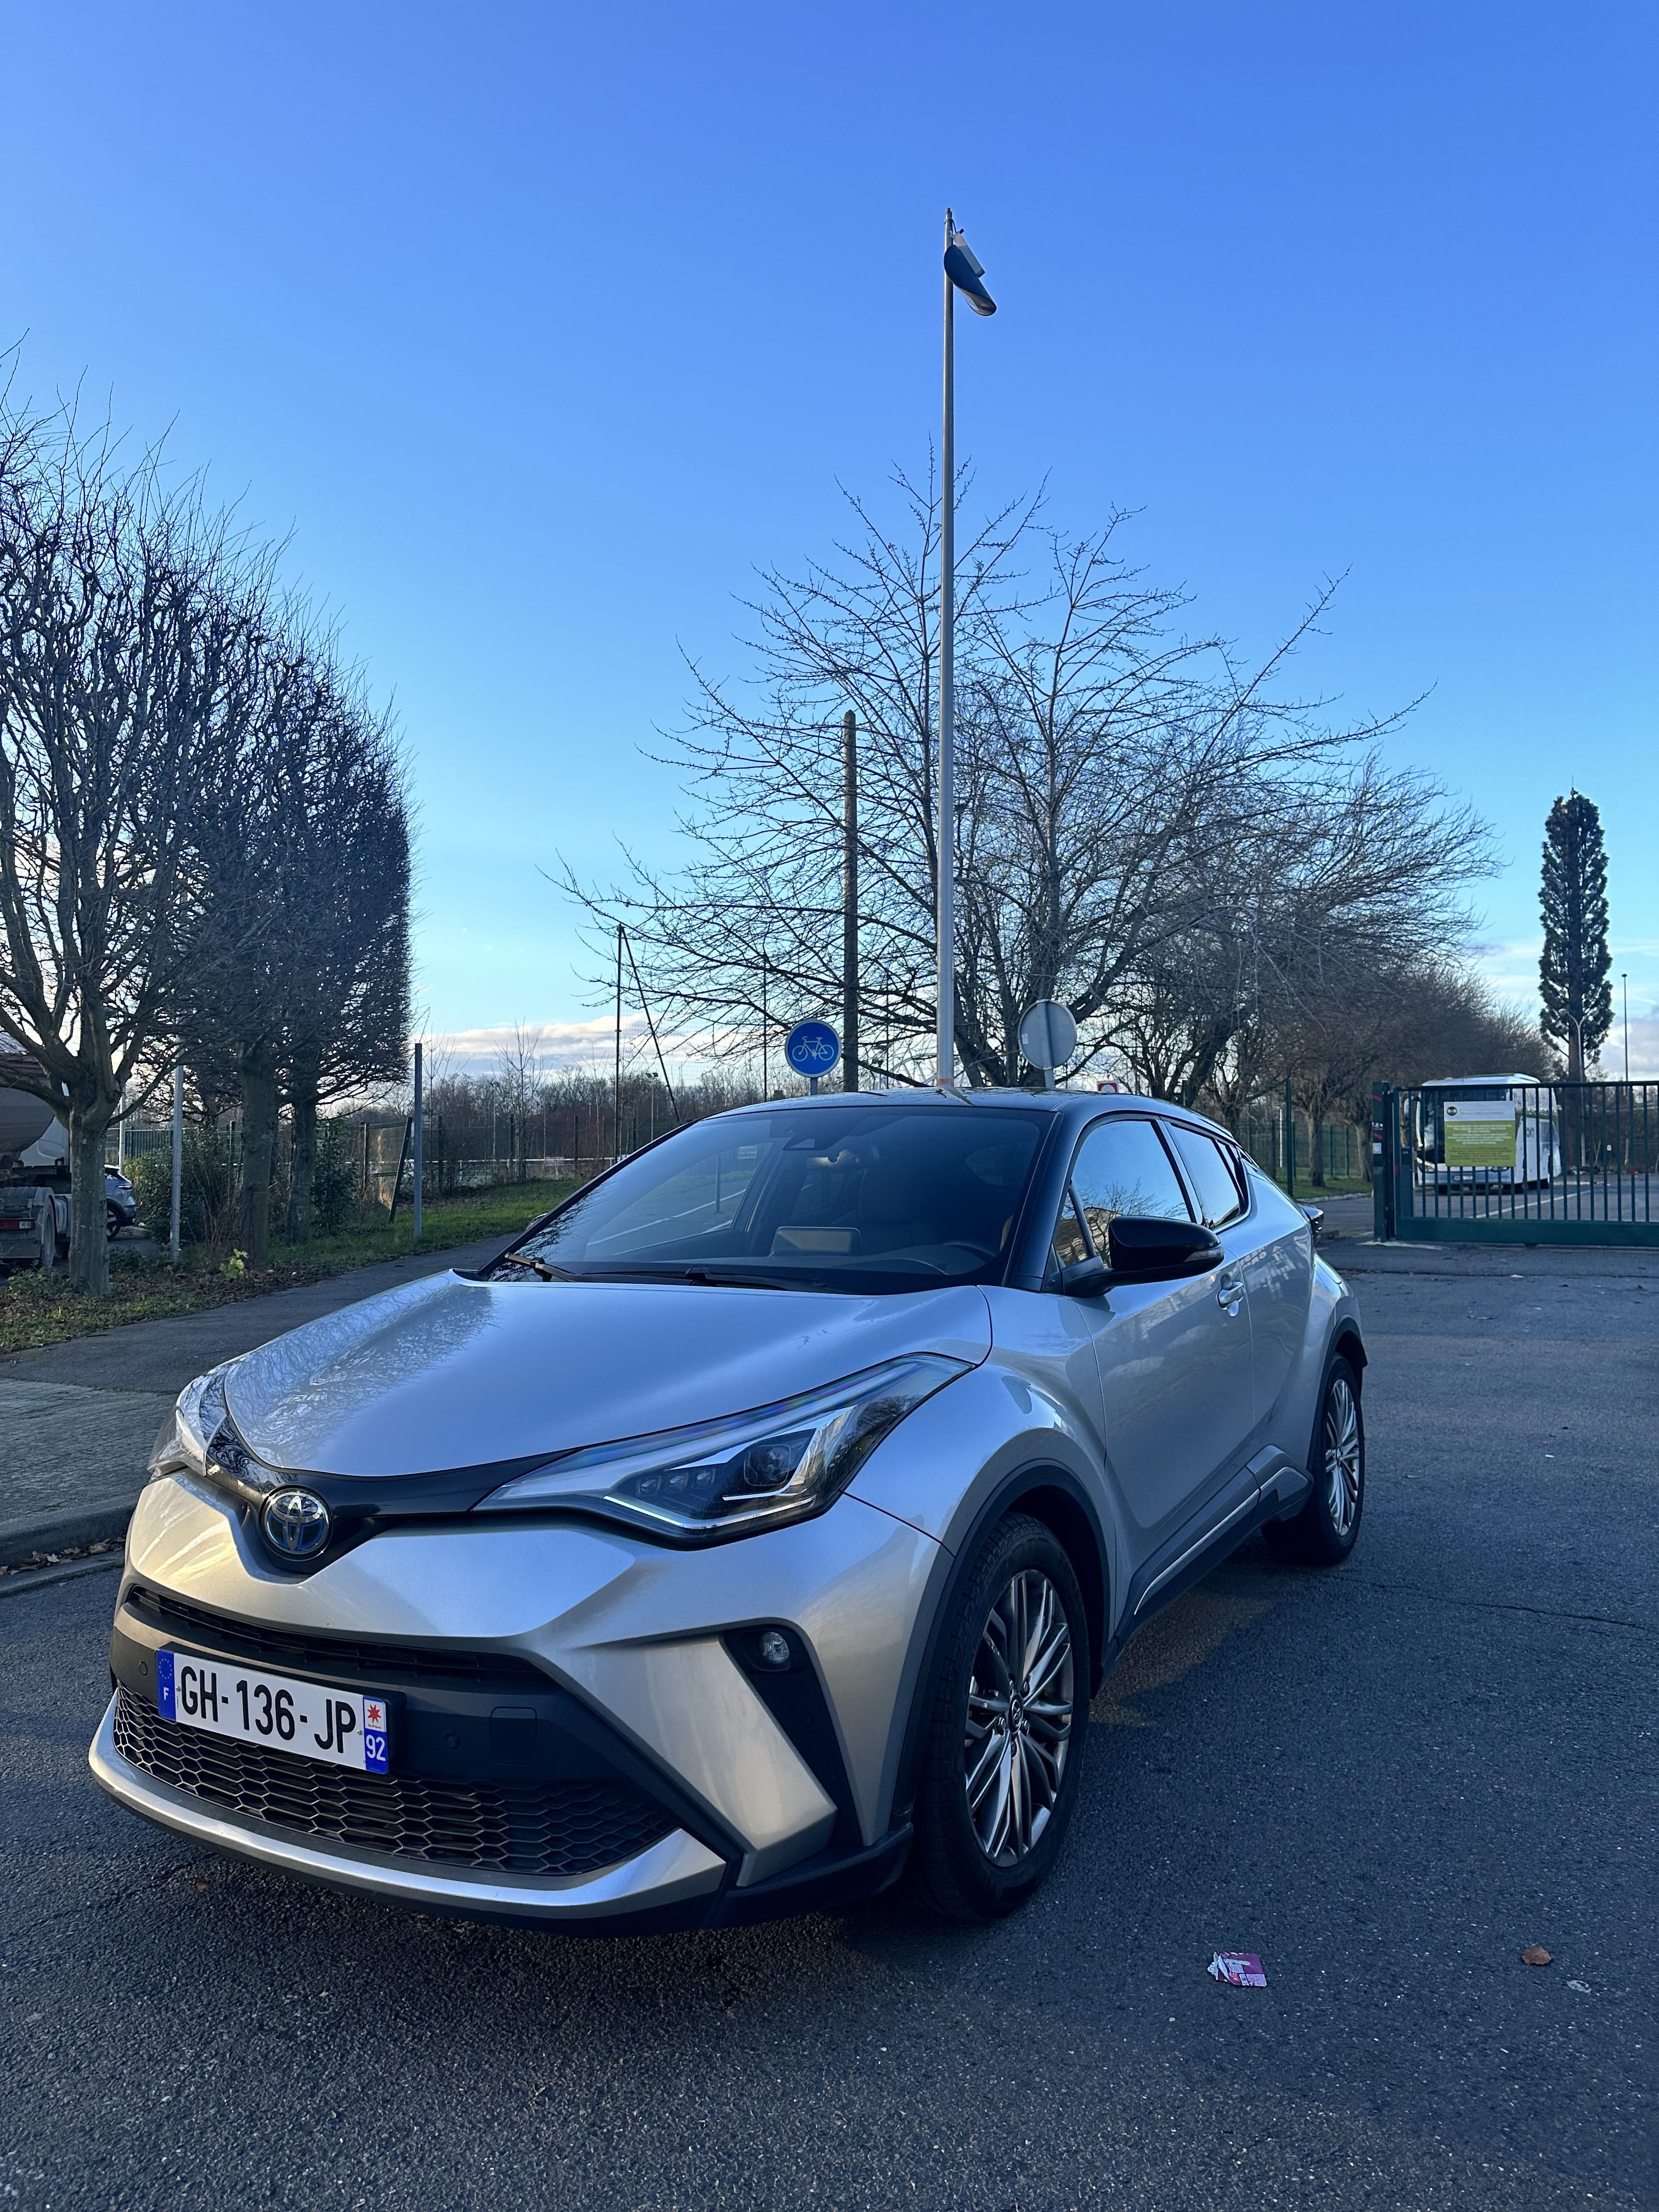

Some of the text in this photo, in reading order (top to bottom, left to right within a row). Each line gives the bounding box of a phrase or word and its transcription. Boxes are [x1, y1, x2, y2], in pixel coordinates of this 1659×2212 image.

[163, 1686, 169, 1700] F
[180, 1666, 356, 1753] GH-136-JP
[366, 1734, 386, 1762] 92
